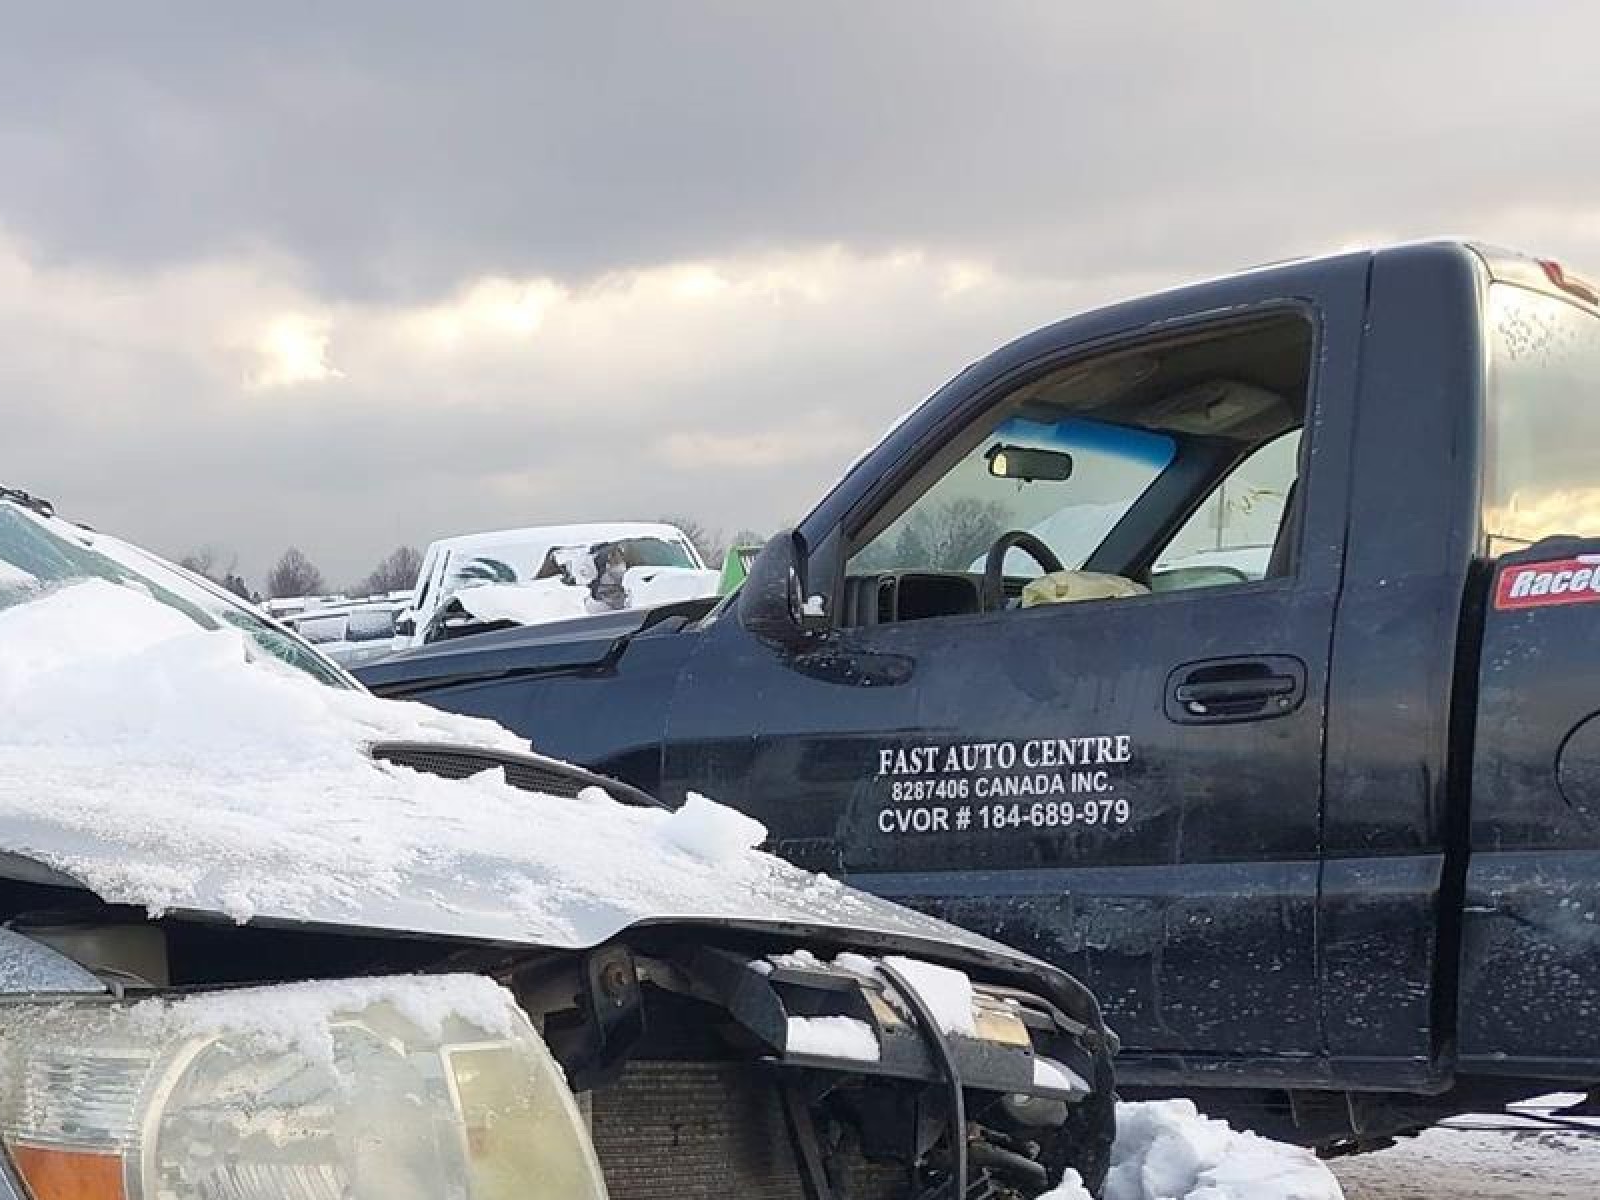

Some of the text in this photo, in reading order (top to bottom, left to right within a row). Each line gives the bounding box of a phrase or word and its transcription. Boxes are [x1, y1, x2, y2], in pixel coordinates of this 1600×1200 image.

[878, 735, 1132, 776] FAST AUTO CENTRE
[891, 770, 1115, 802] 8287406 CANADA INC.
[877, 799, 1130, 833] CVOR # 184-689-979
